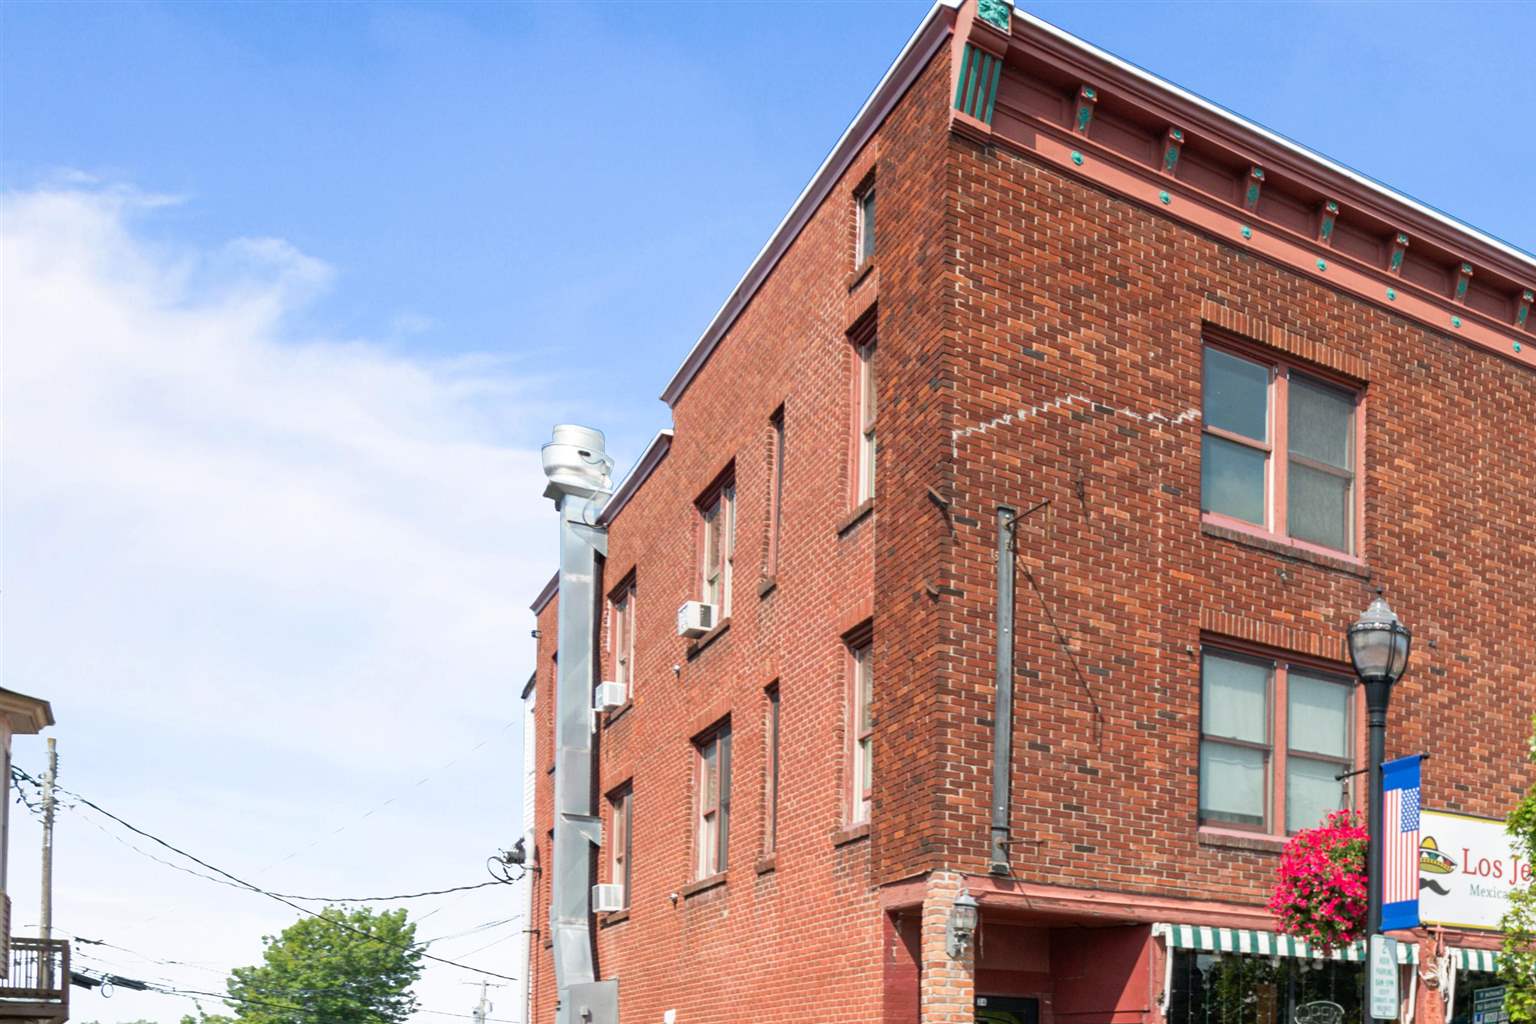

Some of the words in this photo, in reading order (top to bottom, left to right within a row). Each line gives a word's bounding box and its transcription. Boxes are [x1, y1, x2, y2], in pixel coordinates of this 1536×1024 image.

[1462, 847, 1503, 878] Los
[1509, 854, 1533, 885] Je
[1469, 883, 1509, 900] Mexica
